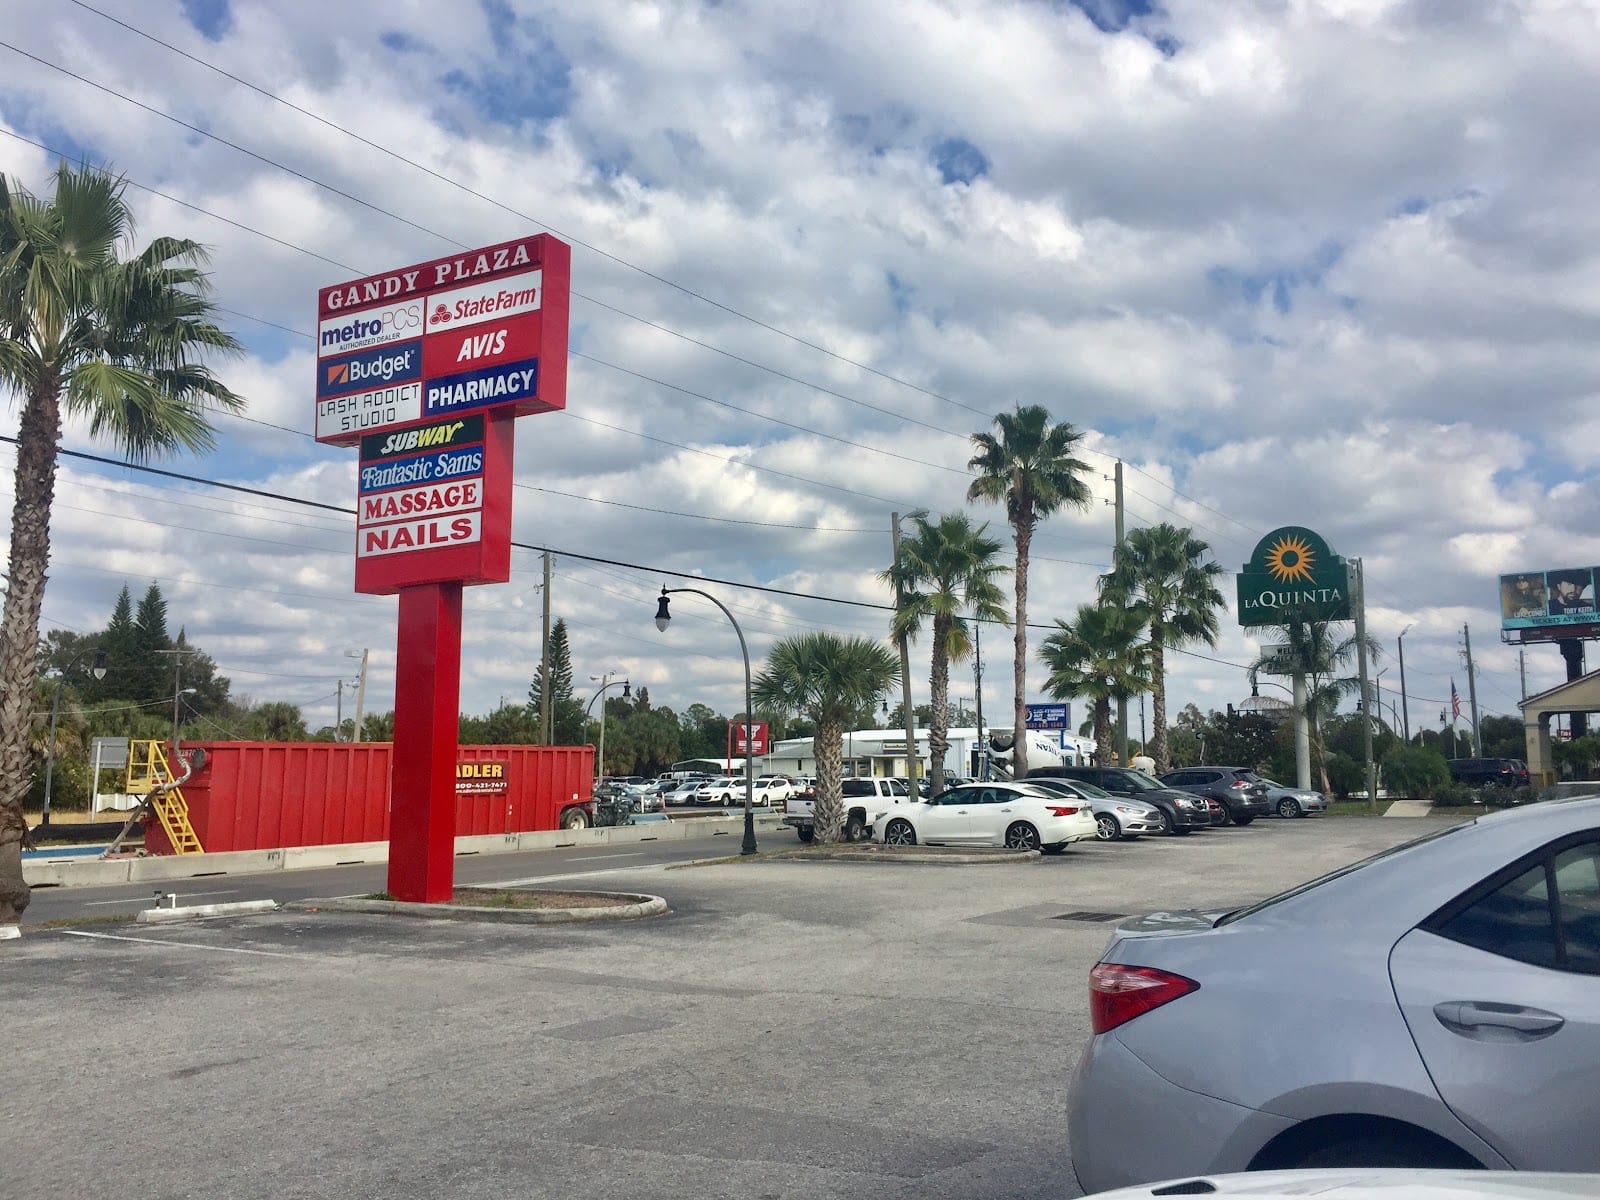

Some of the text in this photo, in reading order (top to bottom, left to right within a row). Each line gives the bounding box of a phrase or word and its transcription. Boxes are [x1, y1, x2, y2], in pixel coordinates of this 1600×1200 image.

[327, 244, 530, 310] GANDY PLAZA
[339, 332, 401, 351] AUTHORIZED DEALER
[456, 329, 508, 362] AVIS
[350, 350, 411, 381] Budget
[320, 384, 419, 417] LASH ADDICT
[428, 368, 535, 409] PHARMACY
[341, 407, 395, 431] STUDIO
[380, 421, 464, 455] SUBWAY
[361, 452, 482, 489] Fantastic Sams
[365, 482, 477, 520] MASSAGE
[366, 518, 473, 552] NAILS
